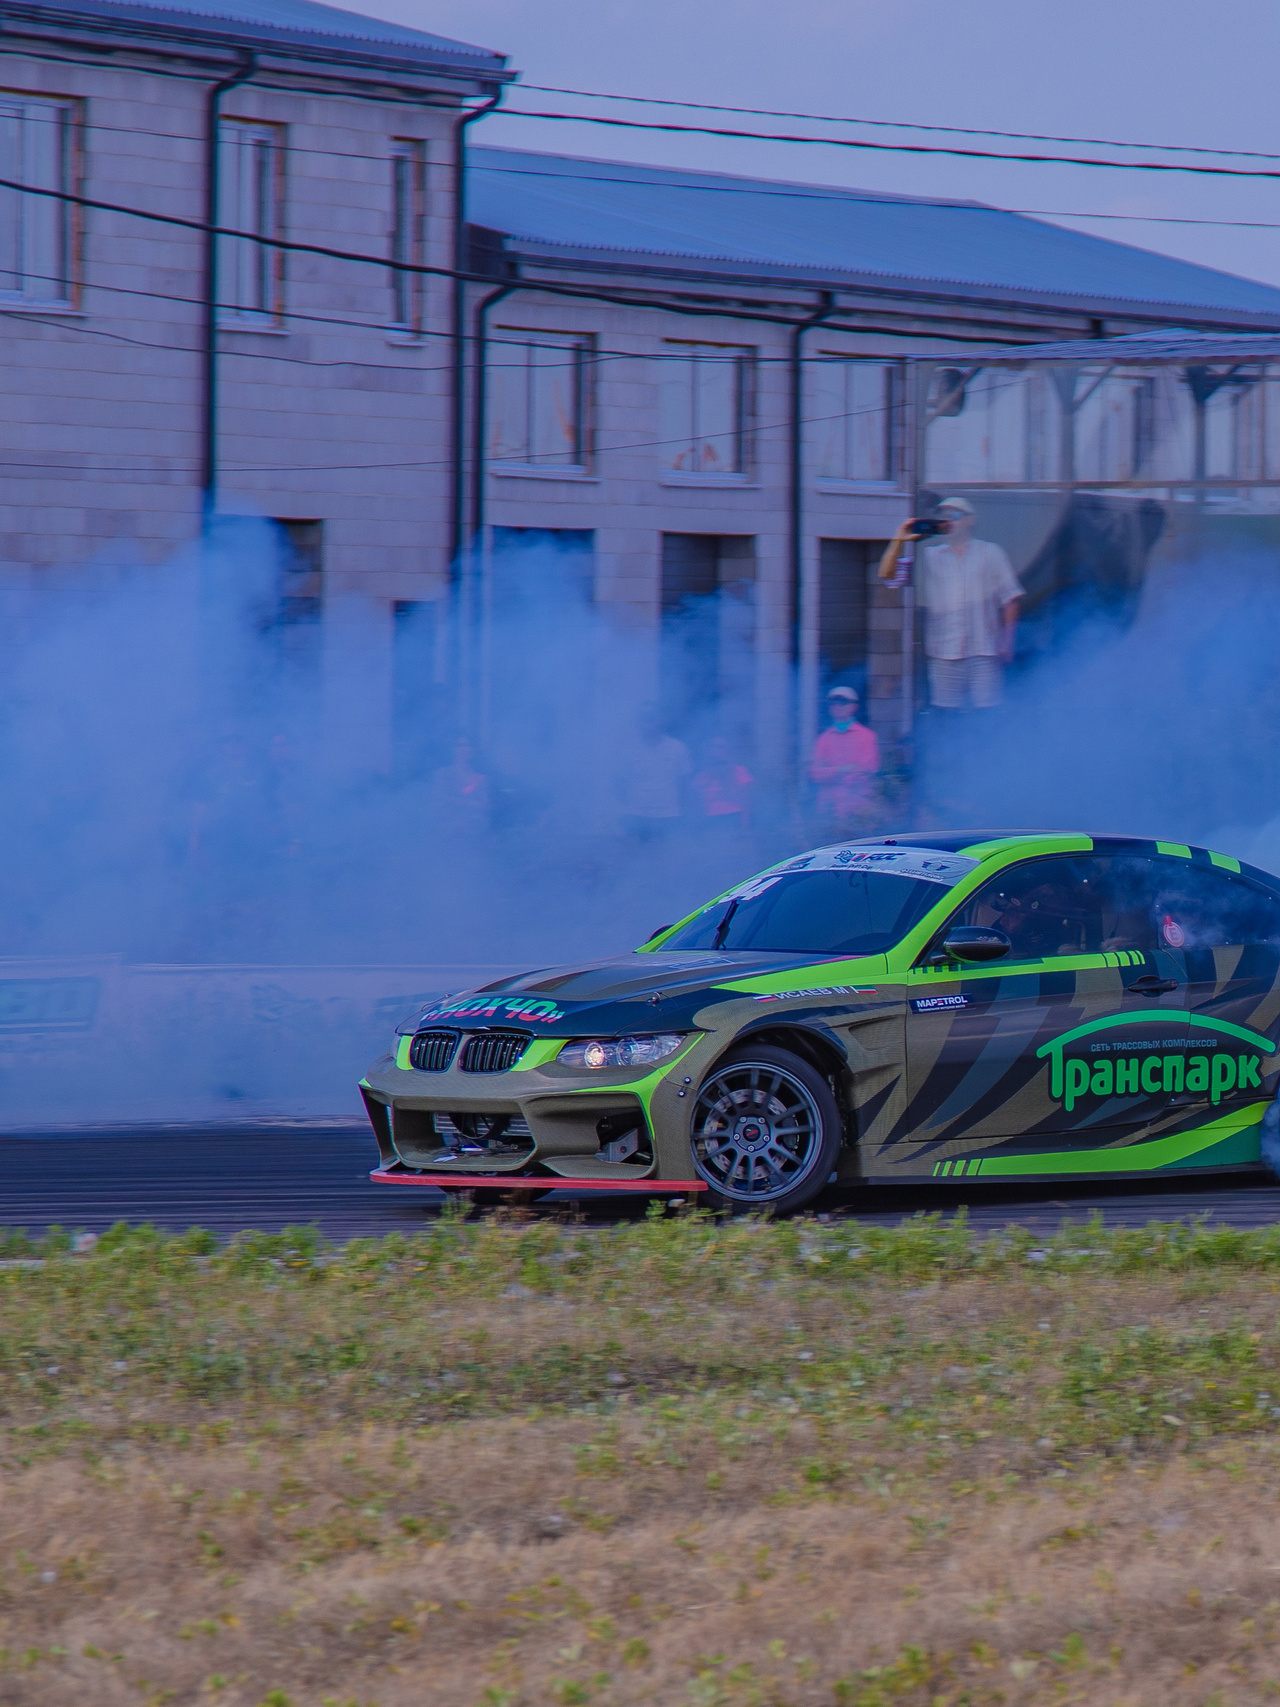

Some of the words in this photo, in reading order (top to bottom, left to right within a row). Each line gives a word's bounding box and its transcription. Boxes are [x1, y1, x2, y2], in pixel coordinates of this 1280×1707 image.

[774, 986, 833, 1000] ИСАЕВ
[916, 996, 968, 1007] MAPETROL
[1090, 1043, 1111, 1052] СЕТЬ
[1112, 1040, 1161, 1051] ТРАССОВЫХ
[1162, 1038, 1218, 1048] КОМПЛЕКСОВ
